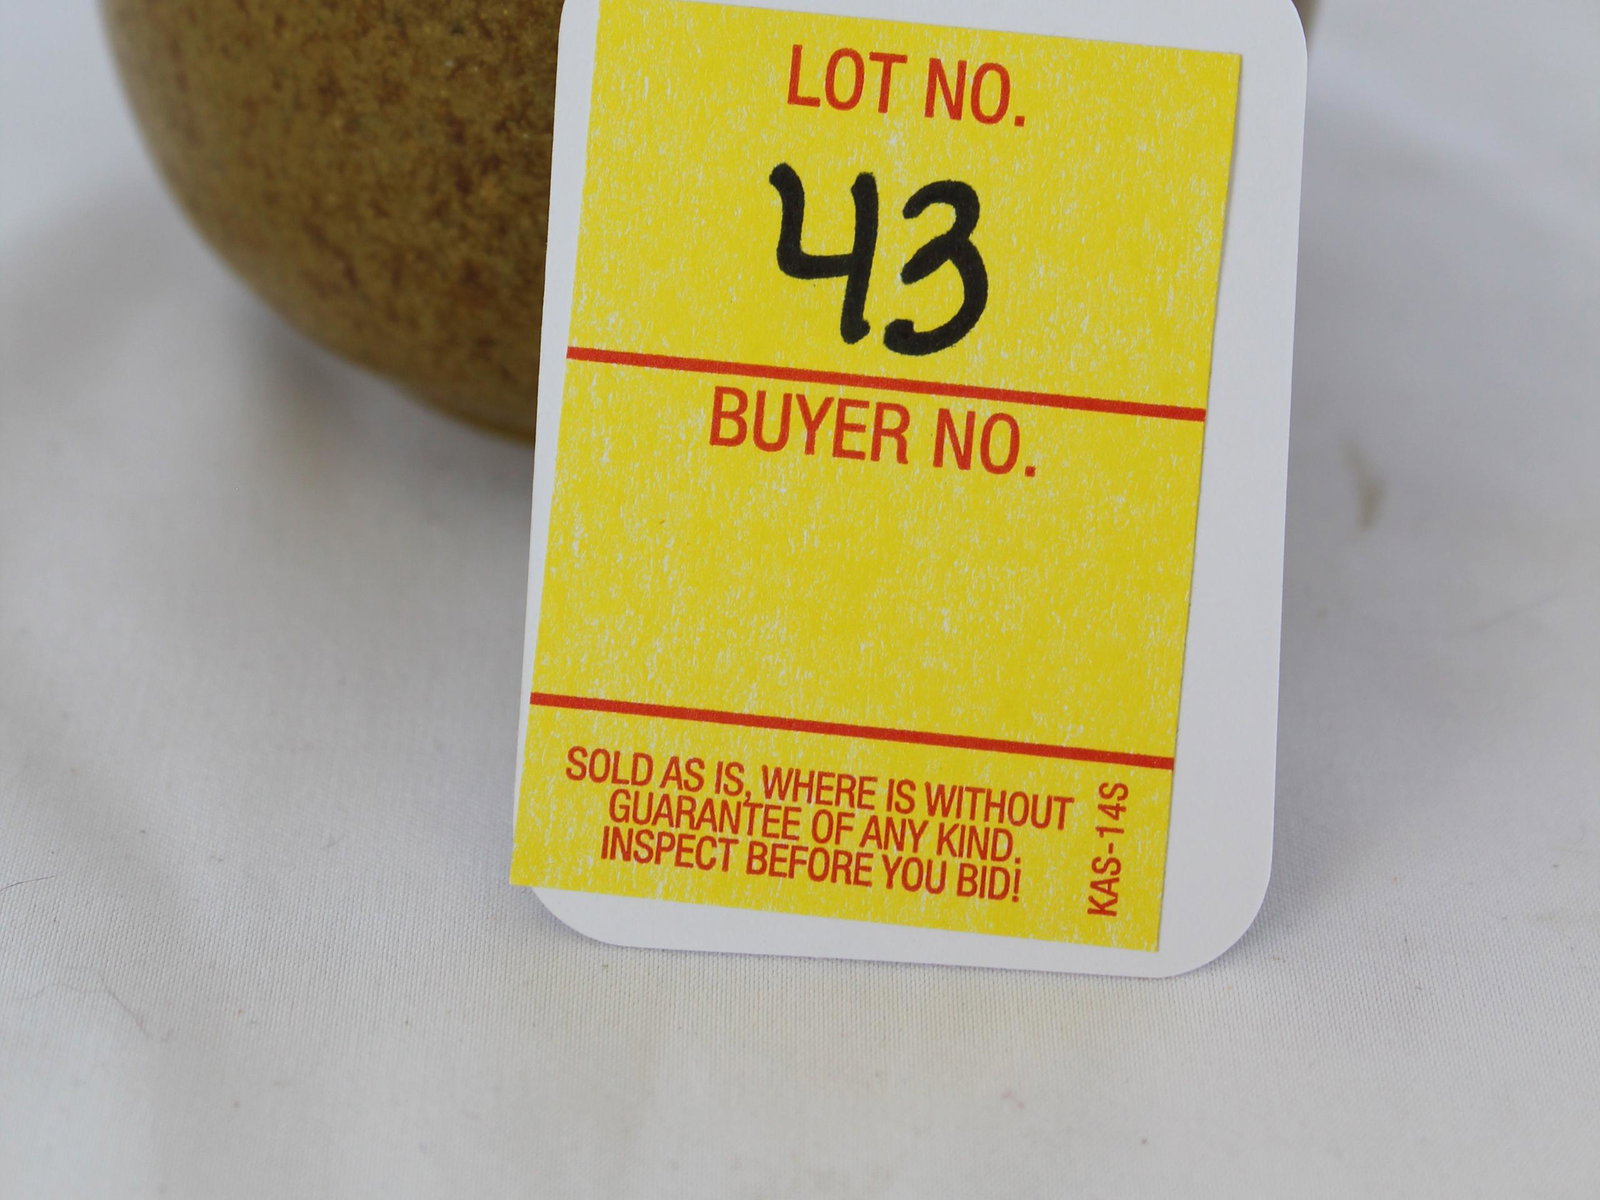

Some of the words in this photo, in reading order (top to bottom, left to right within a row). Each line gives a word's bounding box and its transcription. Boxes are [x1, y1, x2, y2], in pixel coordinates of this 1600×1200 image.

[787, 44, 908, 114] LOT
[924, 57, 1026, 127] NO.
[769, 162, 989, 357] 43
[709, 385, 911, 465] BUYER
[932, 407, 1036, 478] NO.
[565, 746, 654, 787] SOLD
[659, 756, 705, 793] AS
[714, 761, 750, 802] IS,
[761, 765, 878, 811] WHERE
[885, 778, 917, 815] IS
[924, 782, 1076, 831] WITHOUT
[608, 788, 802, 841] GUARANTEE
[811, 809, 855, 846] OF
[859, 815, 929, 854] ANY
[936, 822, 1022, 865] KIND.
[600, 826, 739, 873] INSPECT
[746, 840, 875, 887] BEFORE
[881, 854, 948, 895] YOU
[956, 862, 1022, 903] BID!
[1087, 782, 1130, 917] KAS-14S
